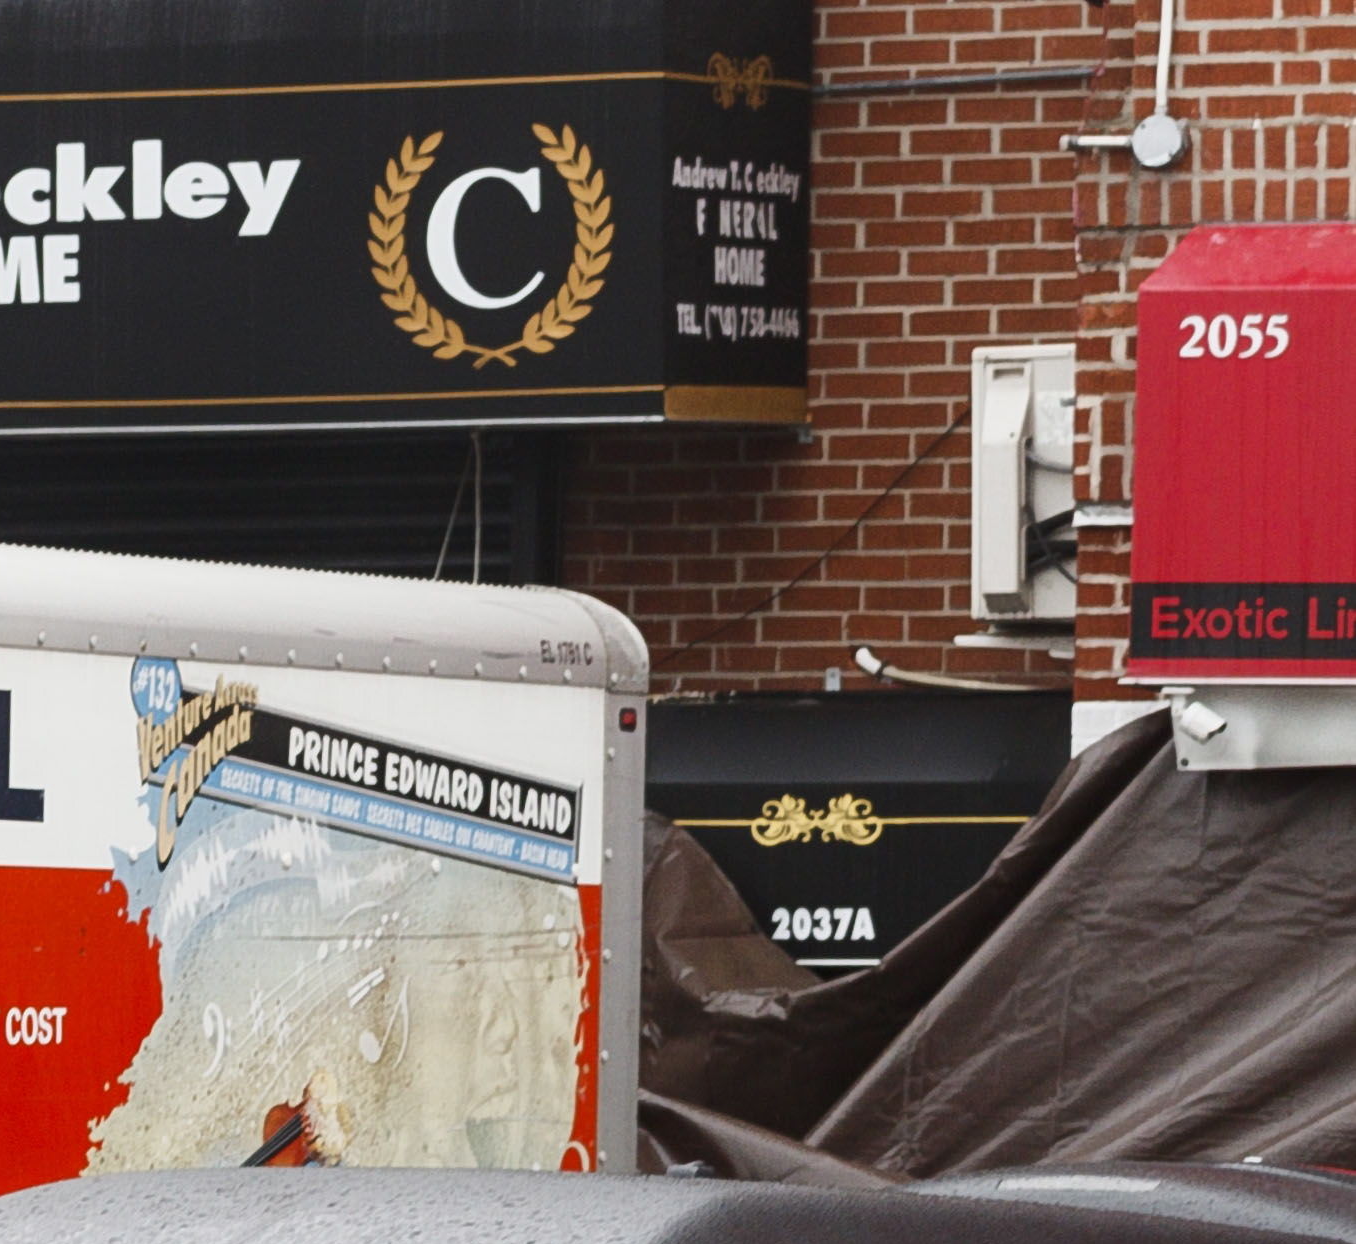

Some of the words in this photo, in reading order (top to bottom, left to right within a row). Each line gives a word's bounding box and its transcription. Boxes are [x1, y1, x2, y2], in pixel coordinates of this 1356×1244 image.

[672, 156, 727, 190] Andrew
[744, 162, 800, 203] Ceckley
[425, 167, 545, 310] C
[696, 198, 778, 240] FNERAL
[714, 246, 766, 287] HOME
[1178, 314, 1290, 359] 2055
[1150, 596, 1289, 640] Exotic
[133, 664, 176, 714] #132
[137, 690, 213, 784] Venture
[156, 703, 255, 869] Canada
[288, 725, 379, 787] PRINCE
[385, 752, 484, 815] EDWARD
[489, 778, 572, 835] ISLAND
[771, 907, 876, 942] 2037A
[5, 1007, 68, 1046] COST
